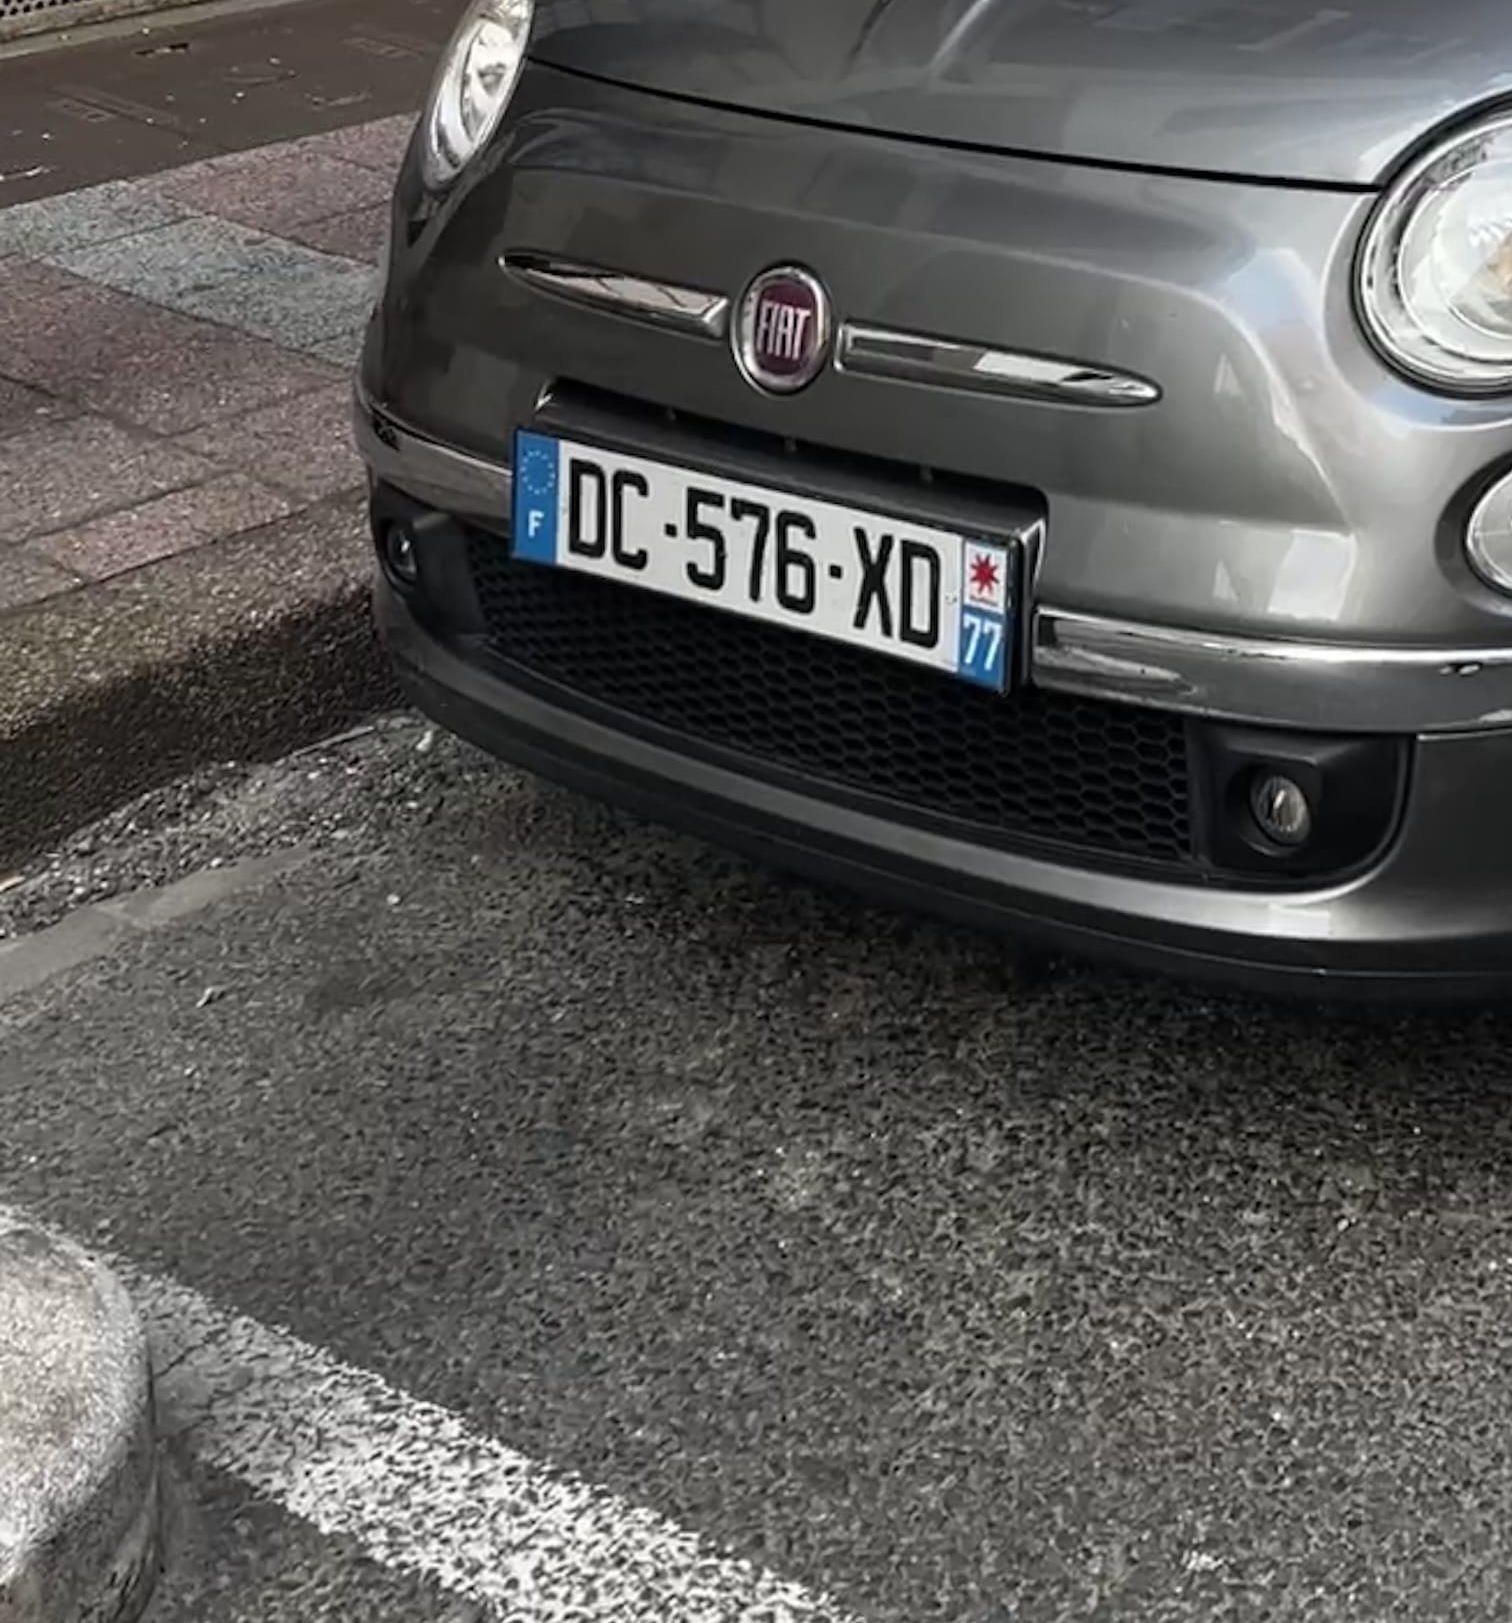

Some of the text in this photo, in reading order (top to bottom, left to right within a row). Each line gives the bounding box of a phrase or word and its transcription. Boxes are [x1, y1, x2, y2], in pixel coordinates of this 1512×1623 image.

[757, 299, 812, 361] FIAT
[527, 509, 545, 538] F
[963, 611, 1003, 671] 77
